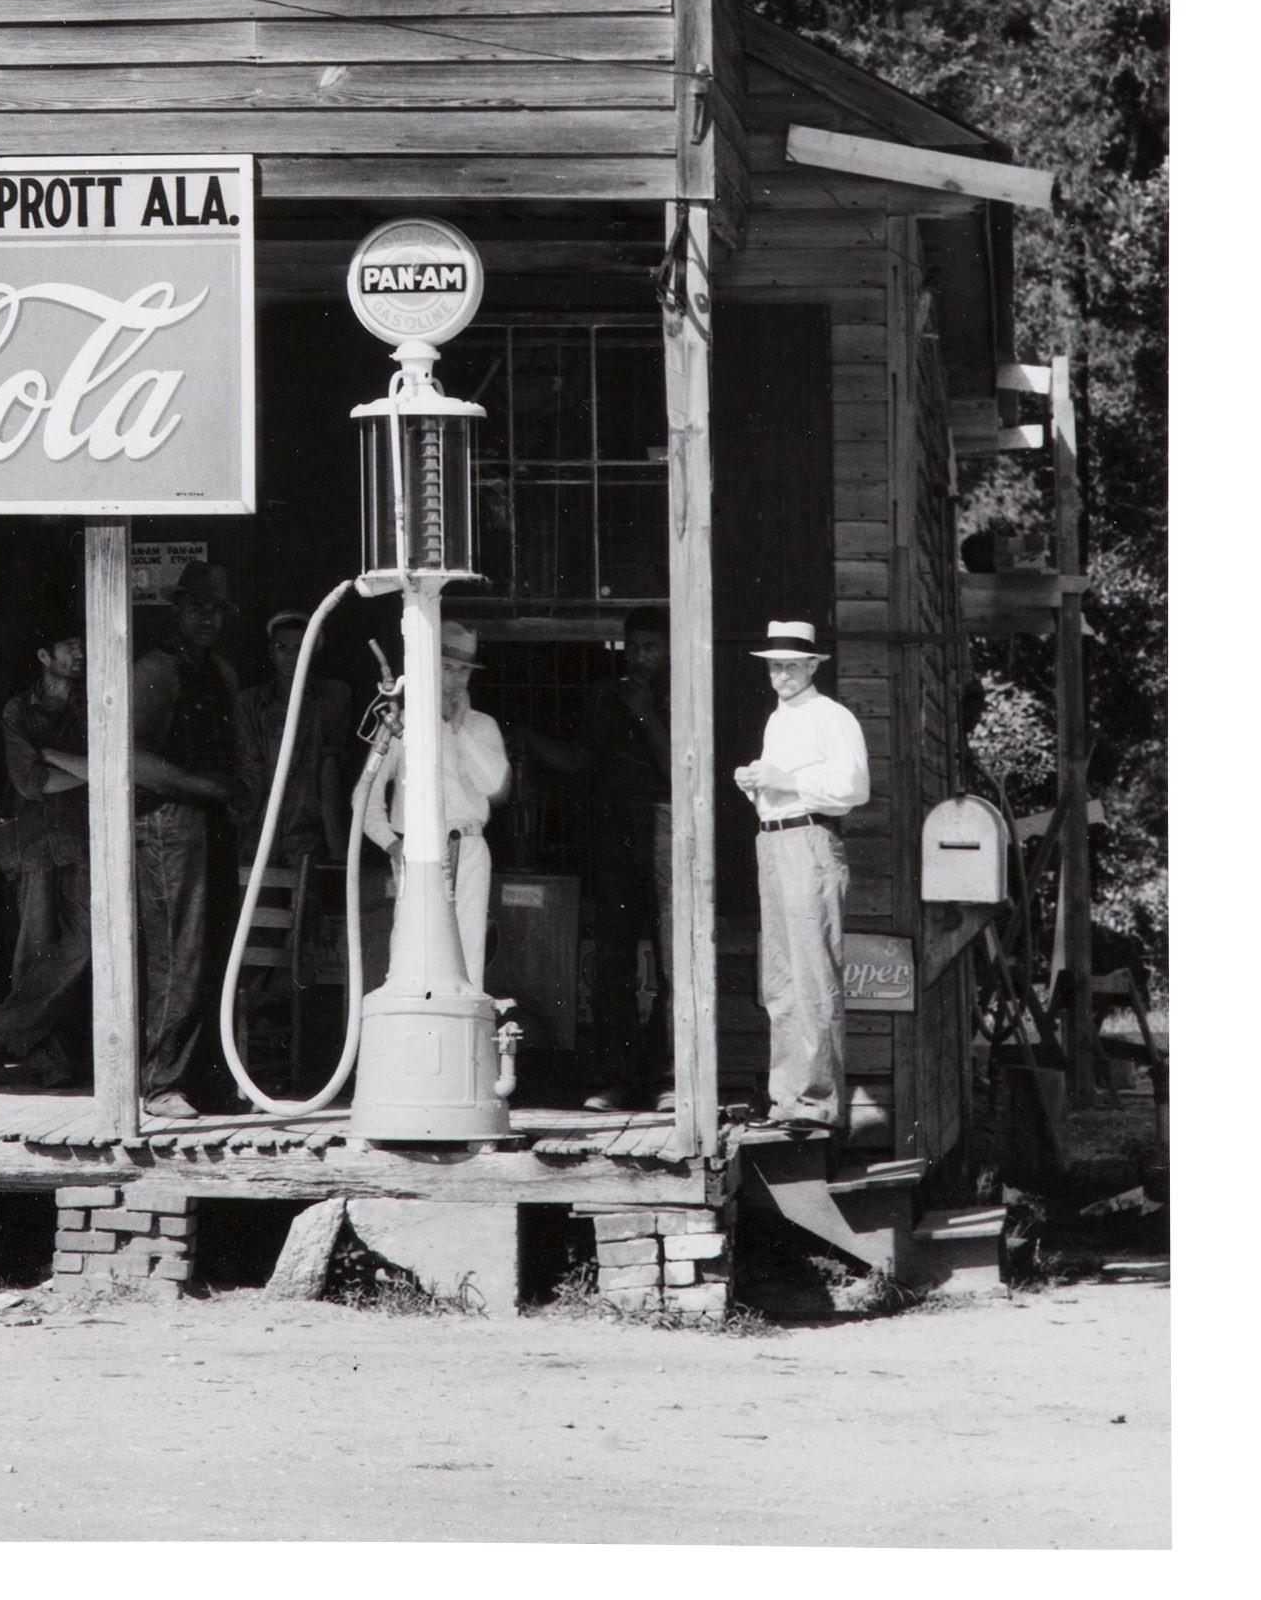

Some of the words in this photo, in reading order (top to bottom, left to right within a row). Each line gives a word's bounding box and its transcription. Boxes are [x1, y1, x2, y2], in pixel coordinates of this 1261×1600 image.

[140, 175, 241, 228] ALA.
[363, 266, 463, 291] PAN-AM
[372, 300, 454, 330] GASOLINE
